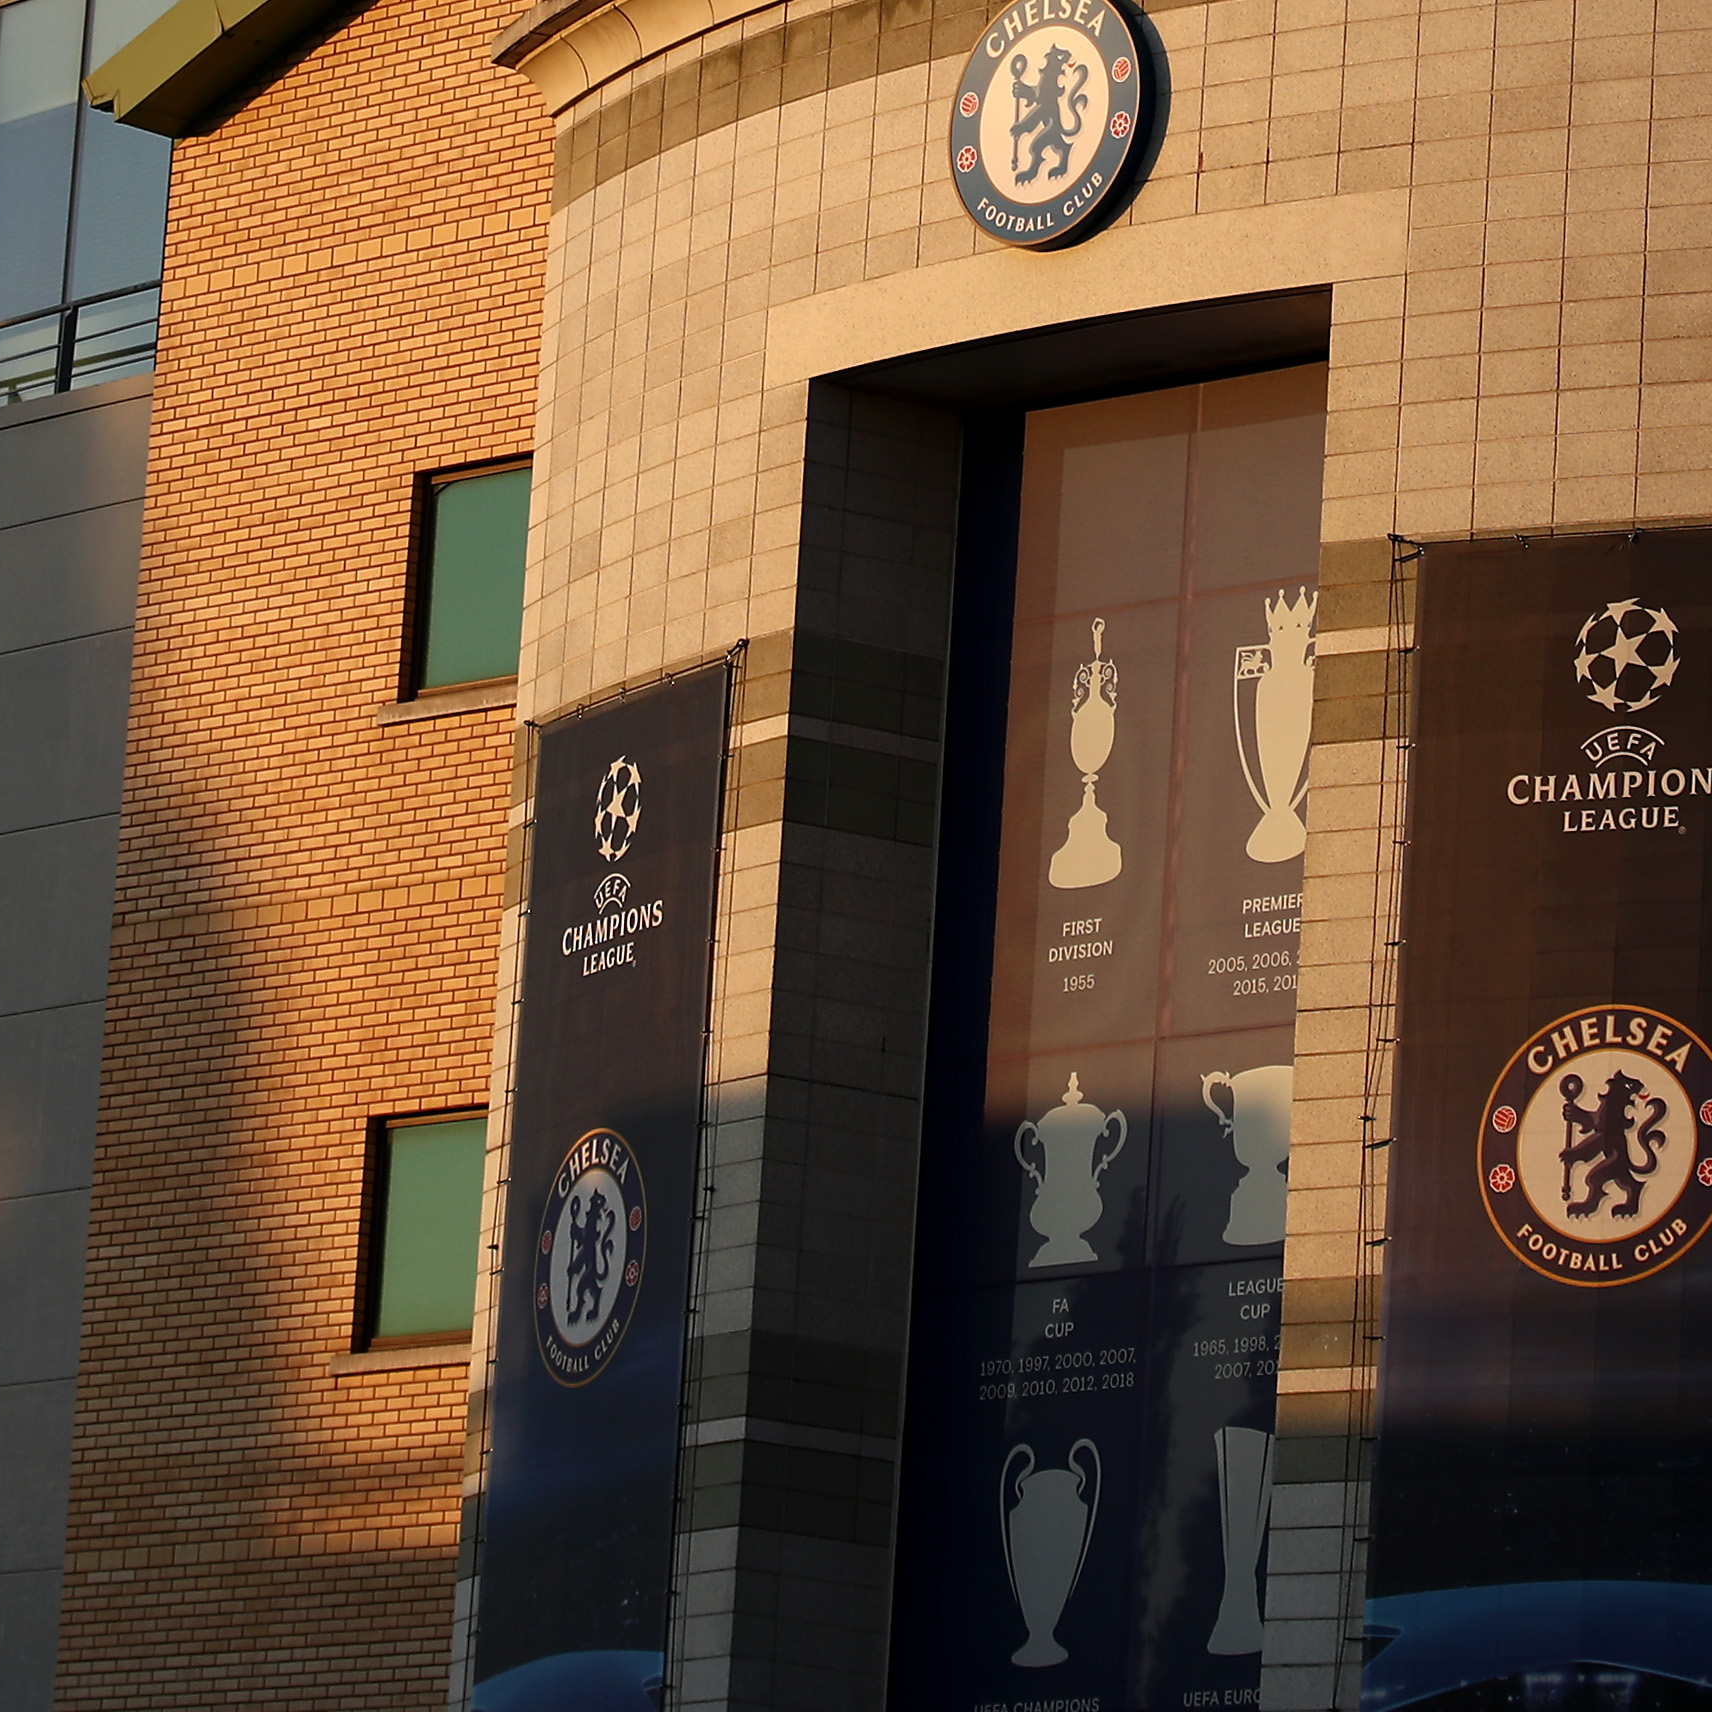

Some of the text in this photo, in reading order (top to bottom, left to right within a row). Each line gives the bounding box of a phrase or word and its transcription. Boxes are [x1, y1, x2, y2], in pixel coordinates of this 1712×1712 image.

[977, 172, 1104, 233] FOOTBALL CLUB
[1584, 732, 1657, 762] UEFA
[1562, 805, 1680, 833] LEAGUE
[595, 879, 628, 909] UEFA
[561, 899, 664, 956] CHAMPIONS
[1062, 917, 1102, 937] FIRST
[1244, 917, 1301, 938] LEAGUE
[582, 941, 635, 977] LEAGUE
[1048, 940, 1113, 963] DIVISION
[1208, 955, 1248, 974] 2005,
[1252, 950, 1292, 970] 2006,
[1063, 974, 1095, 993] 1955
[1233, 974, 1298, 996] 2015, 201
[1527, 1014, 1694, 1076] CHELSEA
[557, 1137, 630, 1199] CHELSEA
[1516, 1218, 1688, 1272] FOOTBALL CLUB
[1228, 1277, 1284, 1297] LEAGUE
[1052, 1298, 1069, 1314] FA
[1240, 1303, 1271, 1320] CUP
[1044, 1321, 1075, 1339] CUP
[545, 1318, 621, 1374] FOOTBALL CLUB
[1193, 1339, 1229, 1357] 1965,
[1233, 1336, 1269, 1354] 1998,
[979, 1347, 1136, 1377] 1970, 1997, 2000, 2007,
[1214, 1362, 1252, 1379] 2007,
[979, 1372, 1134, 1401] 2009, 2010, 2012, 2018
[1013, 1698, 1100, 1712] CHAMPIONS
[1183, 1688, 1261, 1707] UEFA EURO
